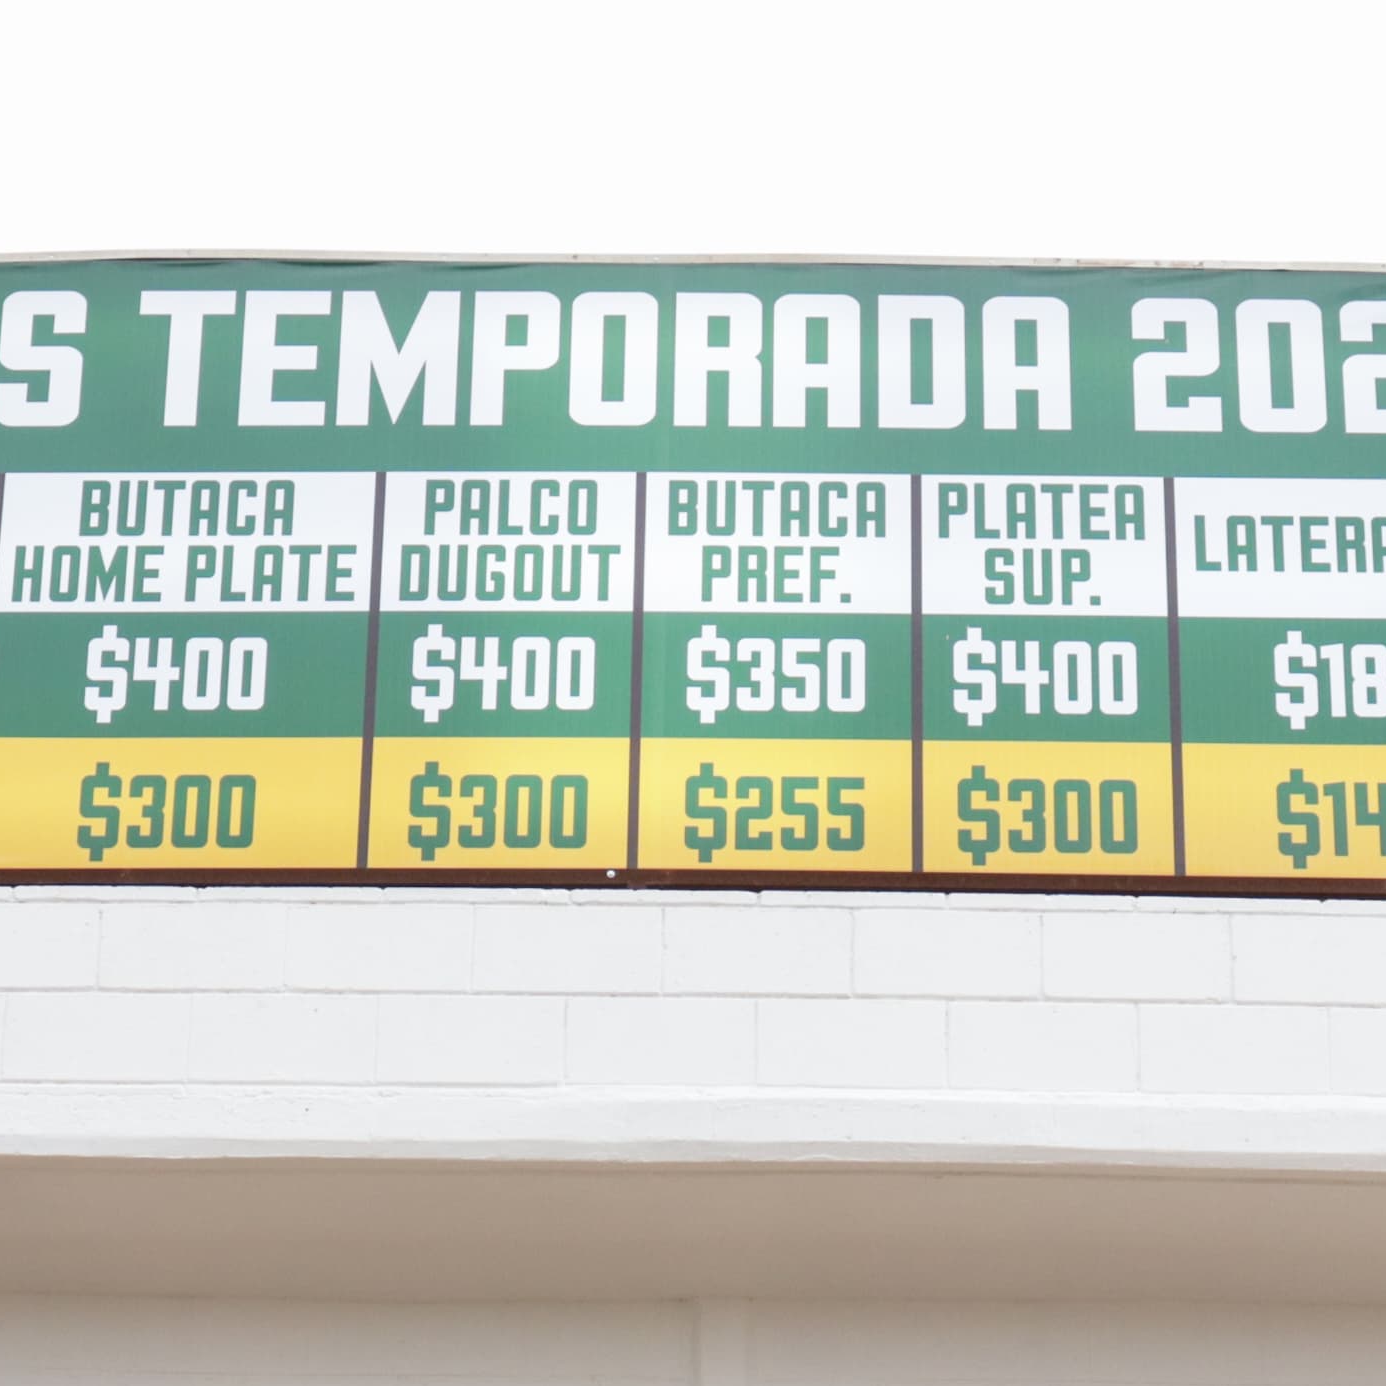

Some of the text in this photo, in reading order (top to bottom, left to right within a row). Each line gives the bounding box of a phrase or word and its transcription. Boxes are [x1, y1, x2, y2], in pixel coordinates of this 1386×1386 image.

[140, 291, 1071, 430] TEMPORADA
[80, 480, 294, 536] BUTACA
[424, 480, 597, 535] PALCO
[669, 480, 885, 537] BUTACA
[939, 483, 1145, 540] PLATEA
[12, 545, 356, 602] HOME PLATE
[399, 545, 620, 601] DUGOUT
[702, 546, 851, 603] PREF.
[985, 549, 1101, 605] SUP.
[85, 625, 267, 723] $400
[411, 624, 595, 722] $400
[687, 625, 865, 723] $350
[953, 627, 1137, 726] $400
[77, 763, 256, 862] $300
[408, 762, 588, 861] $300
[685, 763, 864, 863] $255
[958, 766, 1138, 866] $300
